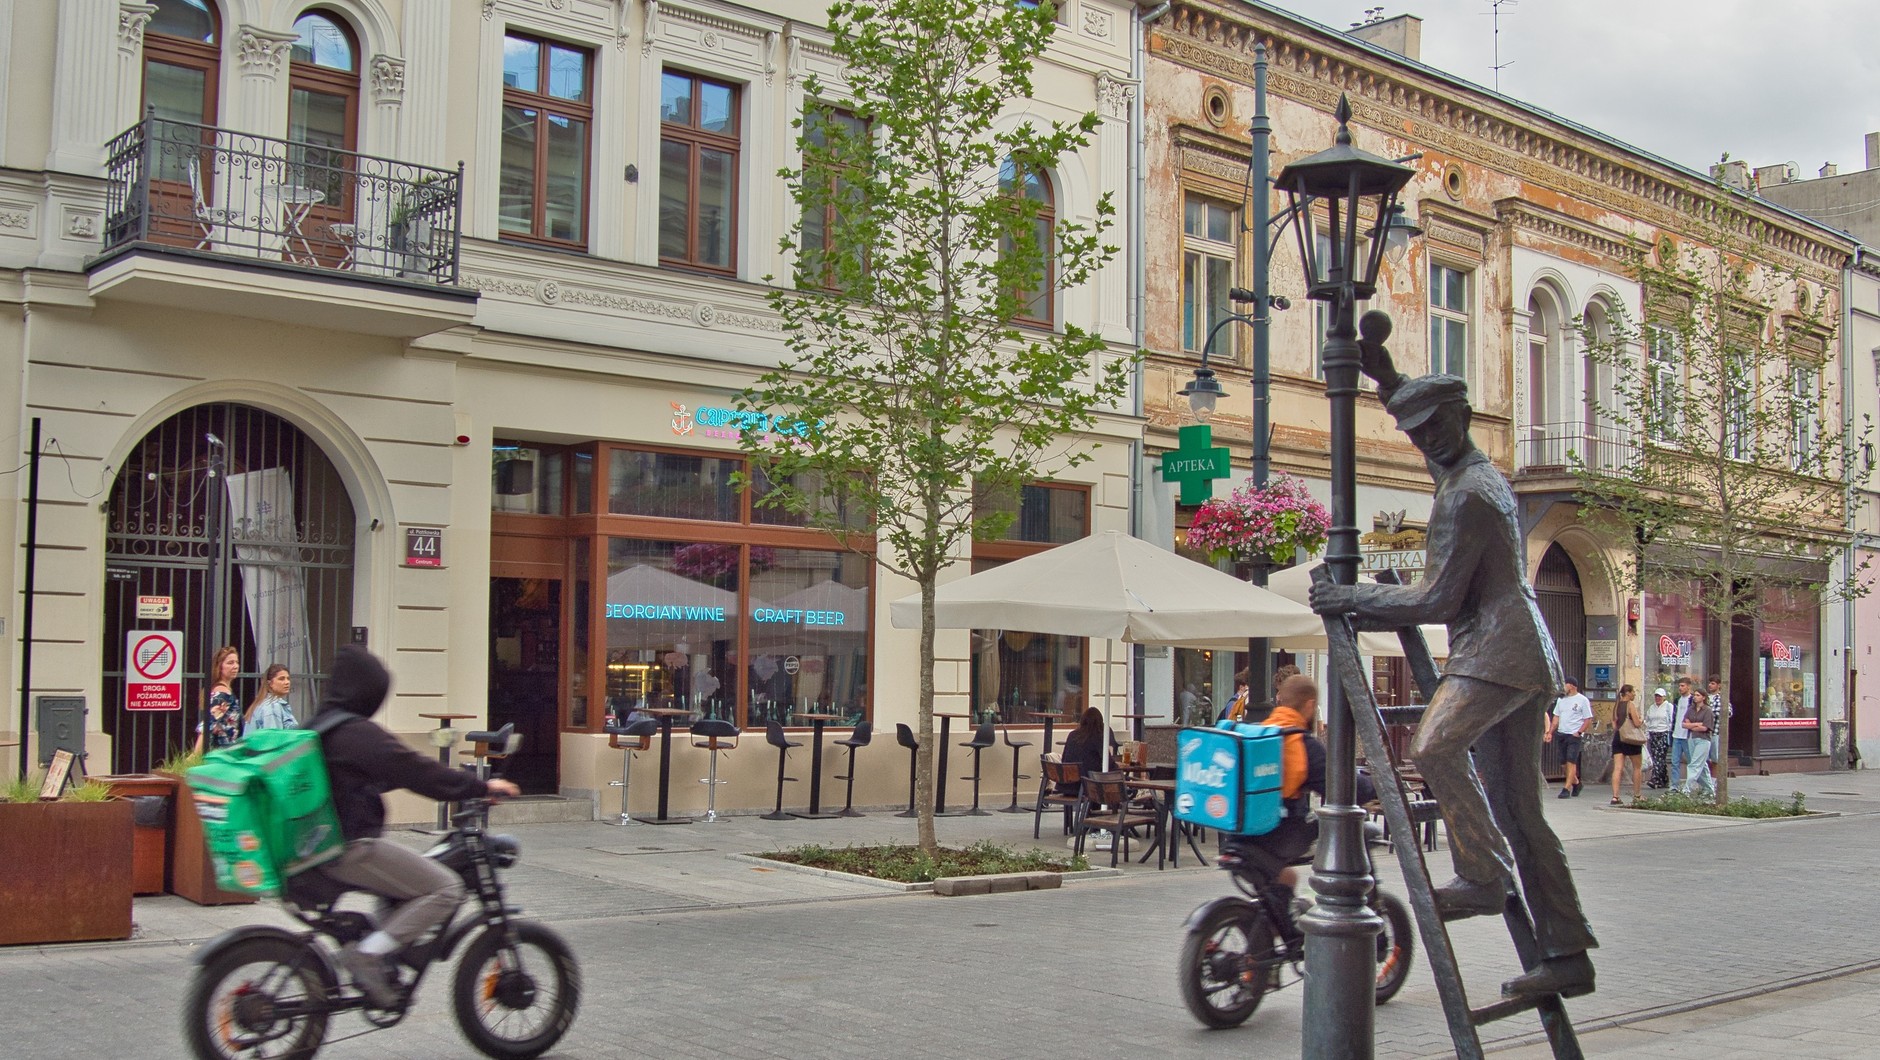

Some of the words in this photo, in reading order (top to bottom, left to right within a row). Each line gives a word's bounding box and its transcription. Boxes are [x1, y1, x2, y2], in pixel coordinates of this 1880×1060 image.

[1168, 459, 1215, 473] APTEKA
[413, 536, 436, 556] 44
[684, 605, 725, 622] WINE
[754, 608, 803, 624] CRAFT
[805, 610, 845, 625] BEER
[142, 699, 177, 707] ZASTAWIAĆ
